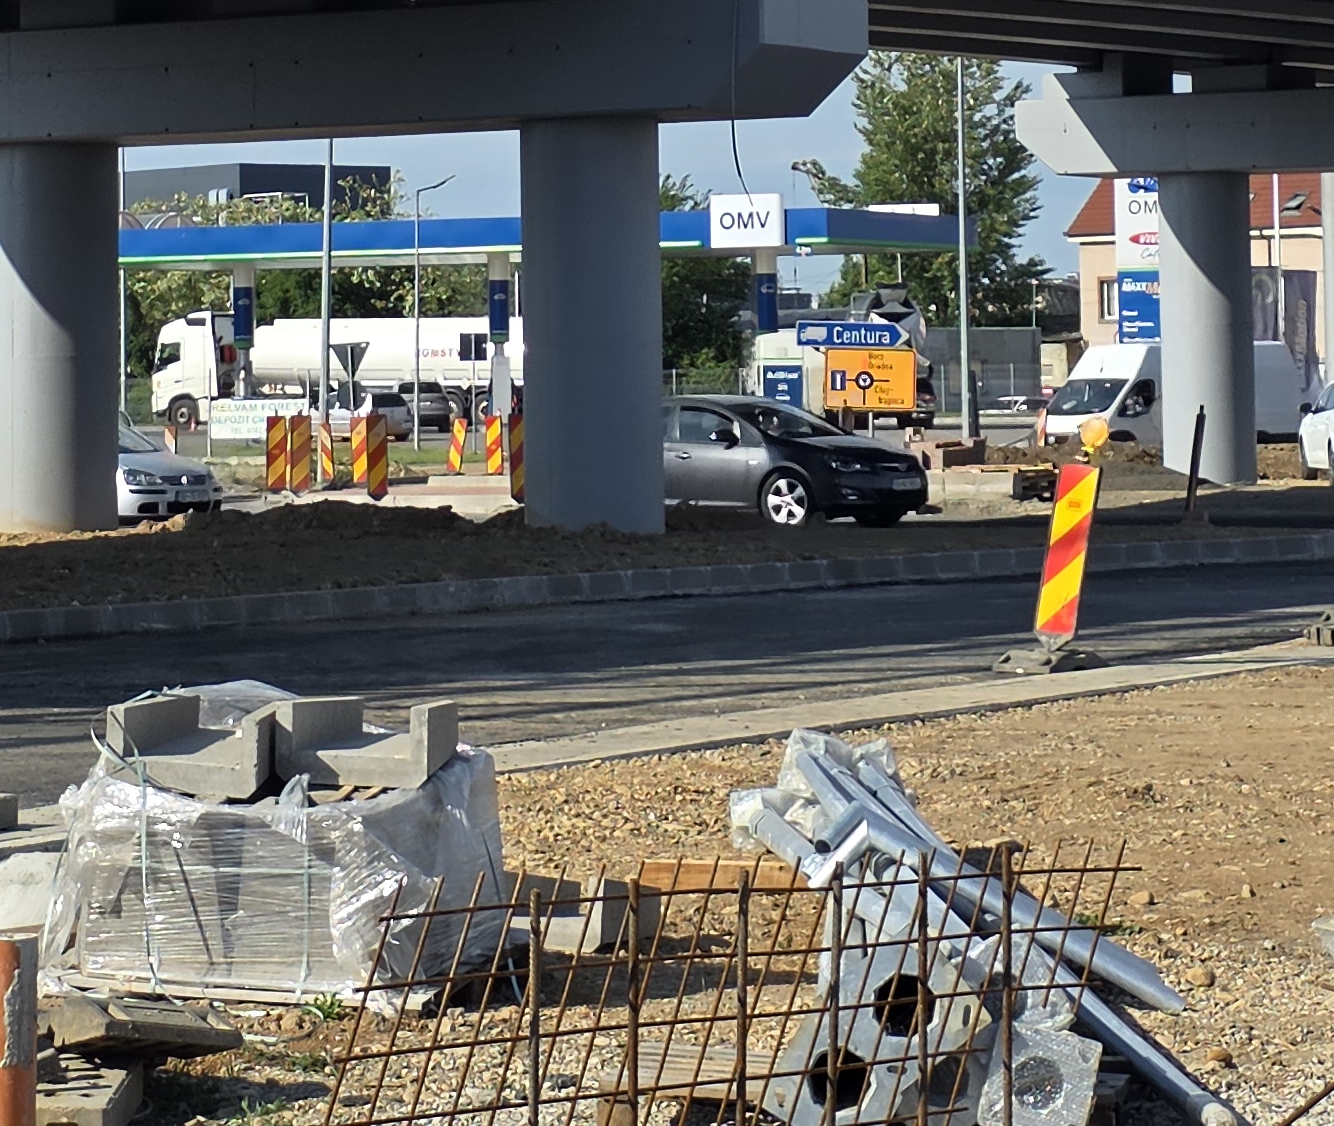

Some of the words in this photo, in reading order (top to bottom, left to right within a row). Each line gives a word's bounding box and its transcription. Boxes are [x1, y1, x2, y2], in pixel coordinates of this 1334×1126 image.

[1128, 200, 1158, 215] OM
[719, 210, 771, 230] OMV
[833, 326, 890, 344] Centura
